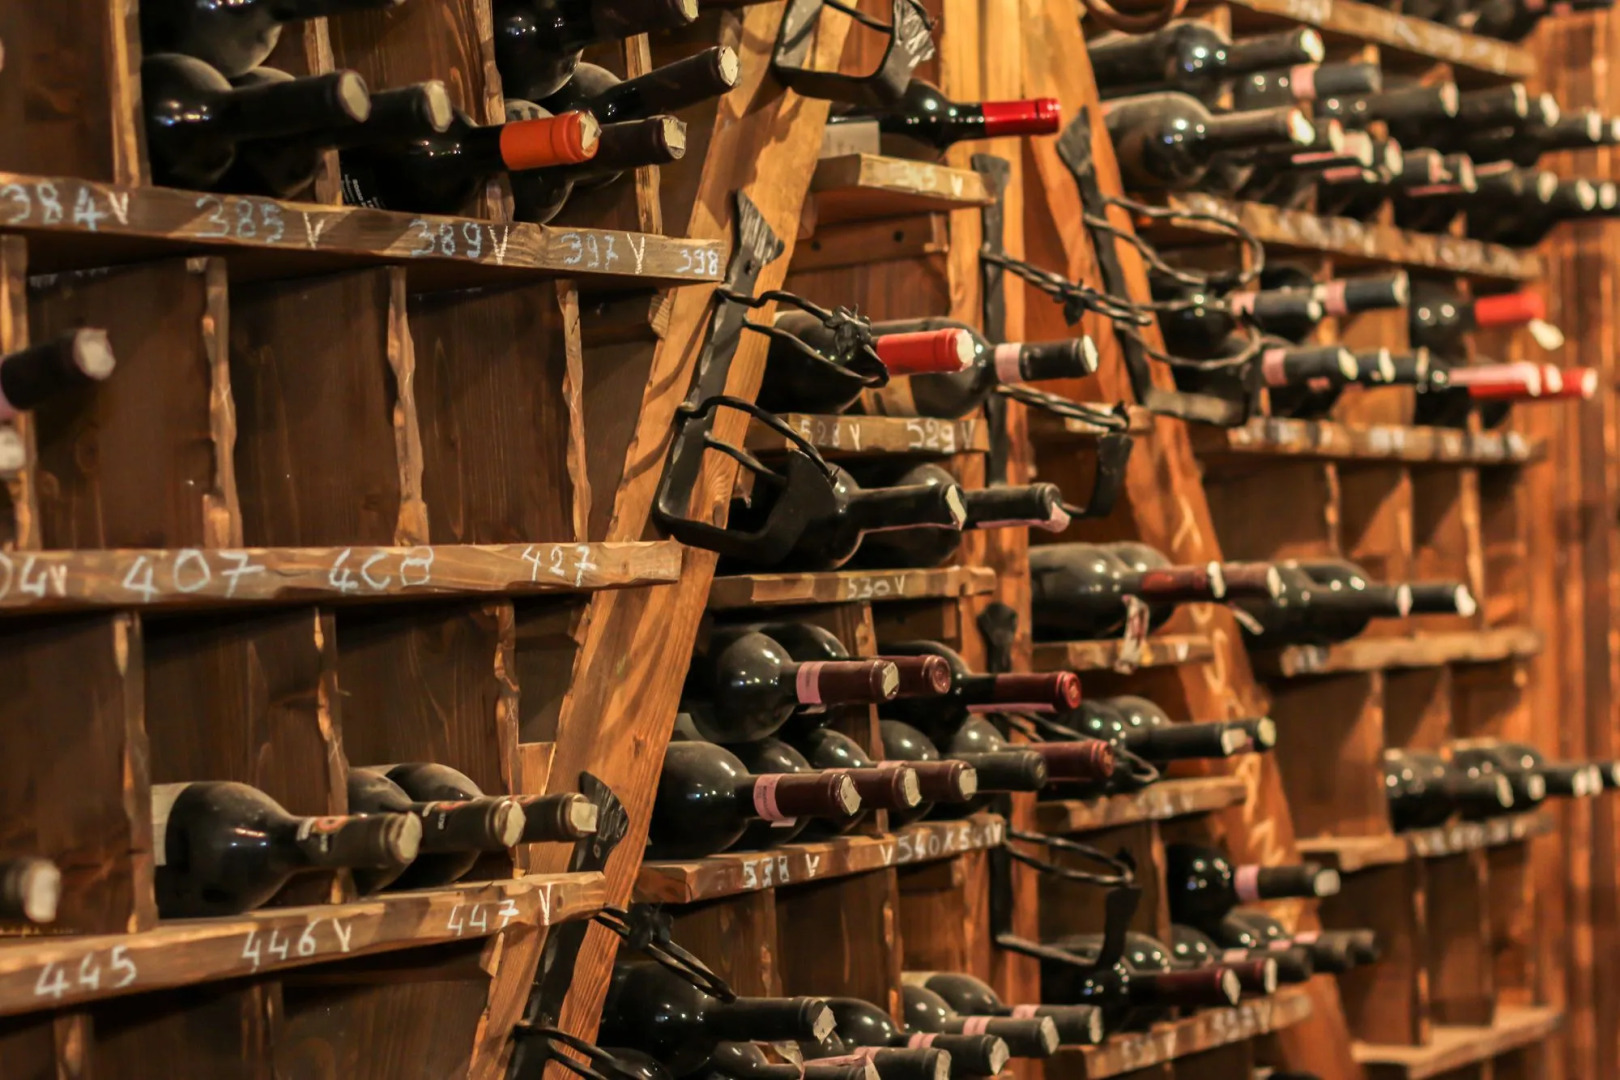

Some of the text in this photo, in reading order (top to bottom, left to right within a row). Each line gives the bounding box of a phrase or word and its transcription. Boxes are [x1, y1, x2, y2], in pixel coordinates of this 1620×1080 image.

[195, 194, 327, 250] 385 V
[674, 248, 718, 276] 398
[906, 418, 956, 454] 529
[122, 547, 265, 602] 407
[521, 545, 597, 588] 427
[447, 898, 520, 937] 447
[242, 916, 352, 974] 446 V
[34, 944, 138, 999] 445
